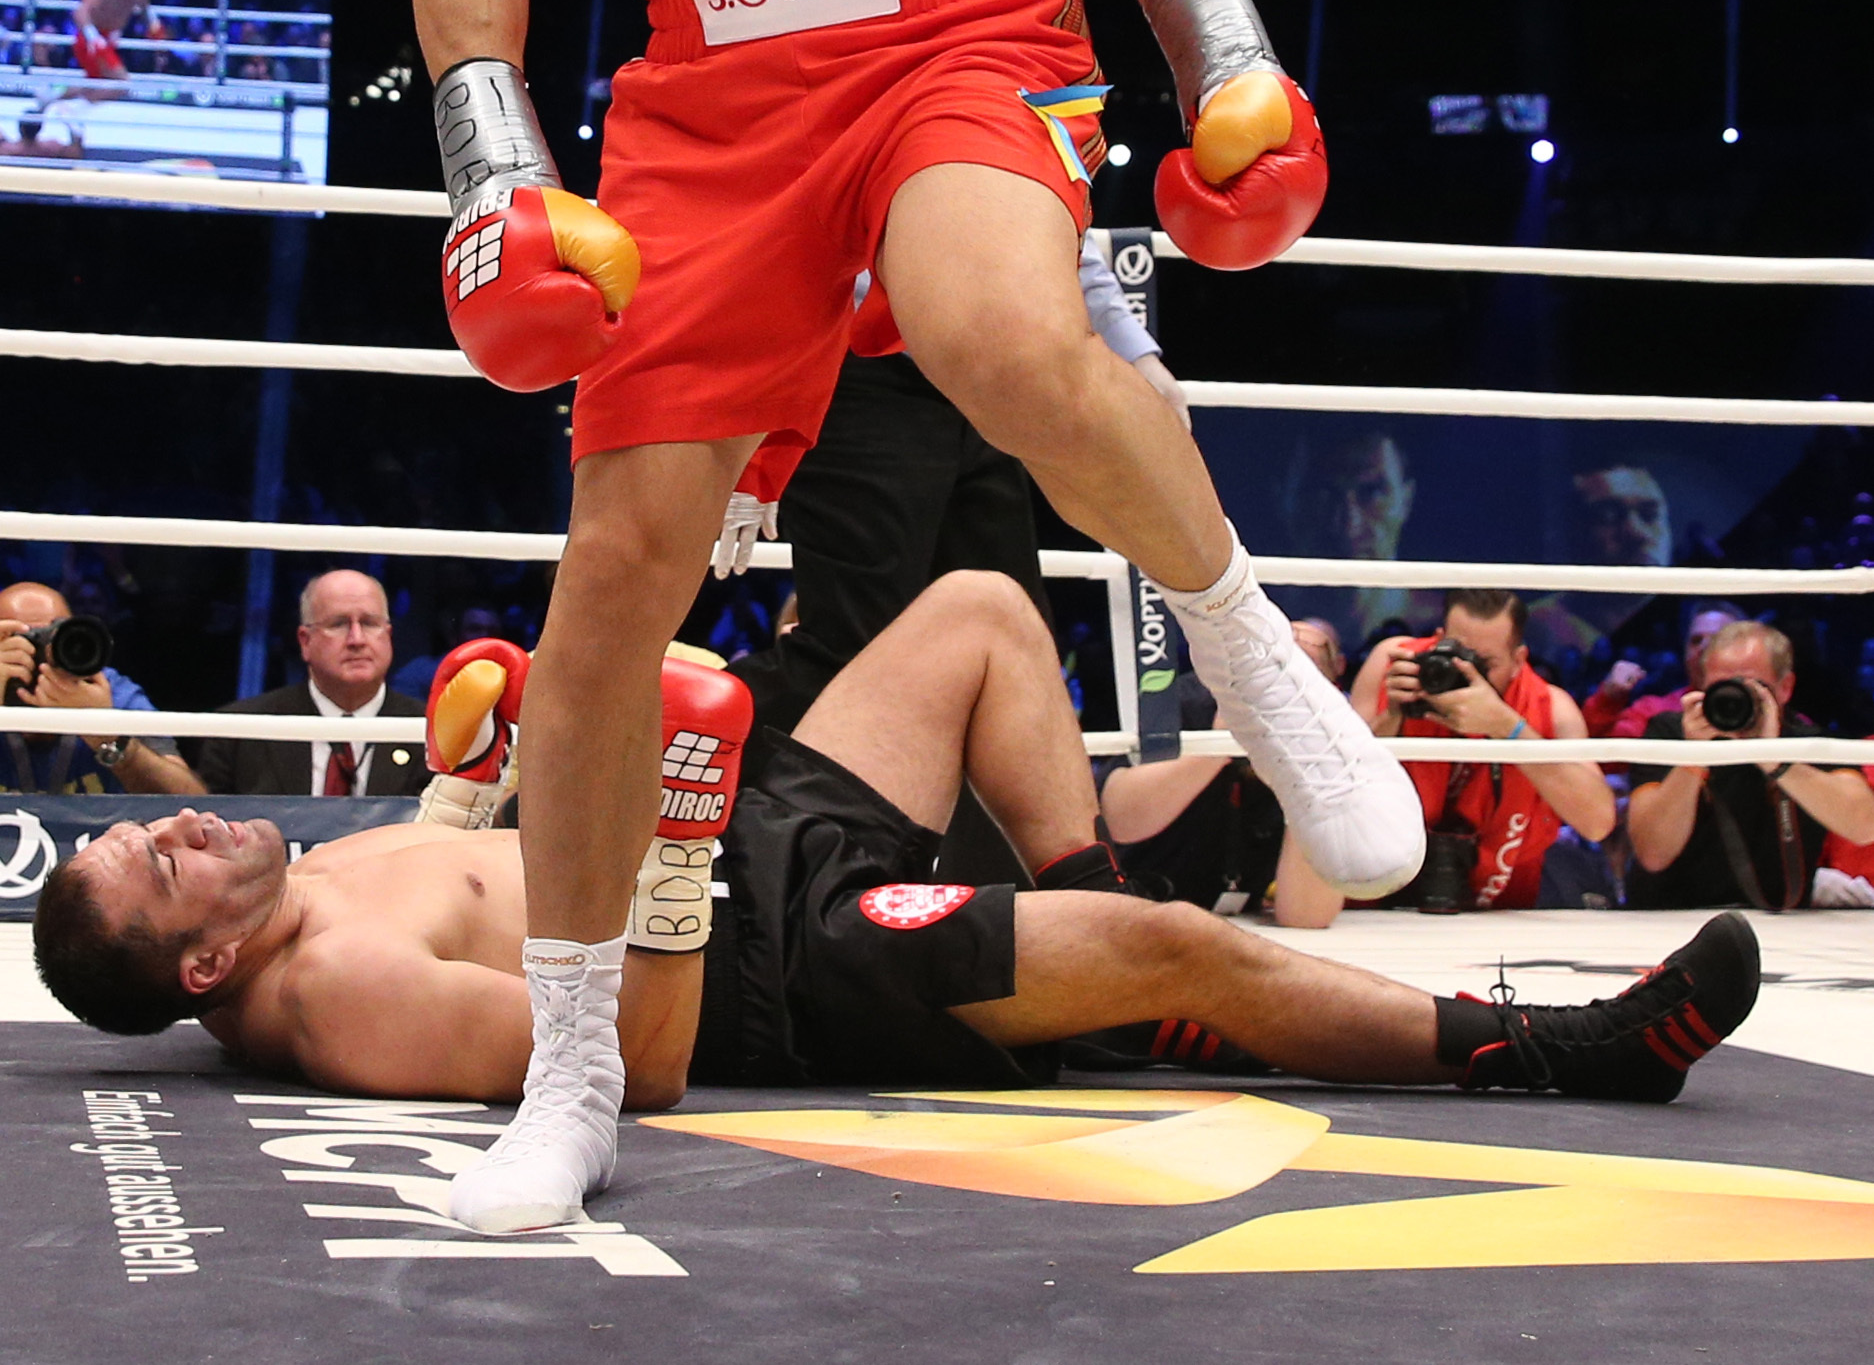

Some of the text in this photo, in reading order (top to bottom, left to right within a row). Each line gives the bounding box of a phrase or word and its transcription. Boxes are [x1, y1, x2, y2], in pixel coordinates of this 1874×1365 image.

[70, 1090, 225, 1283] Einfach gut aussehen.
